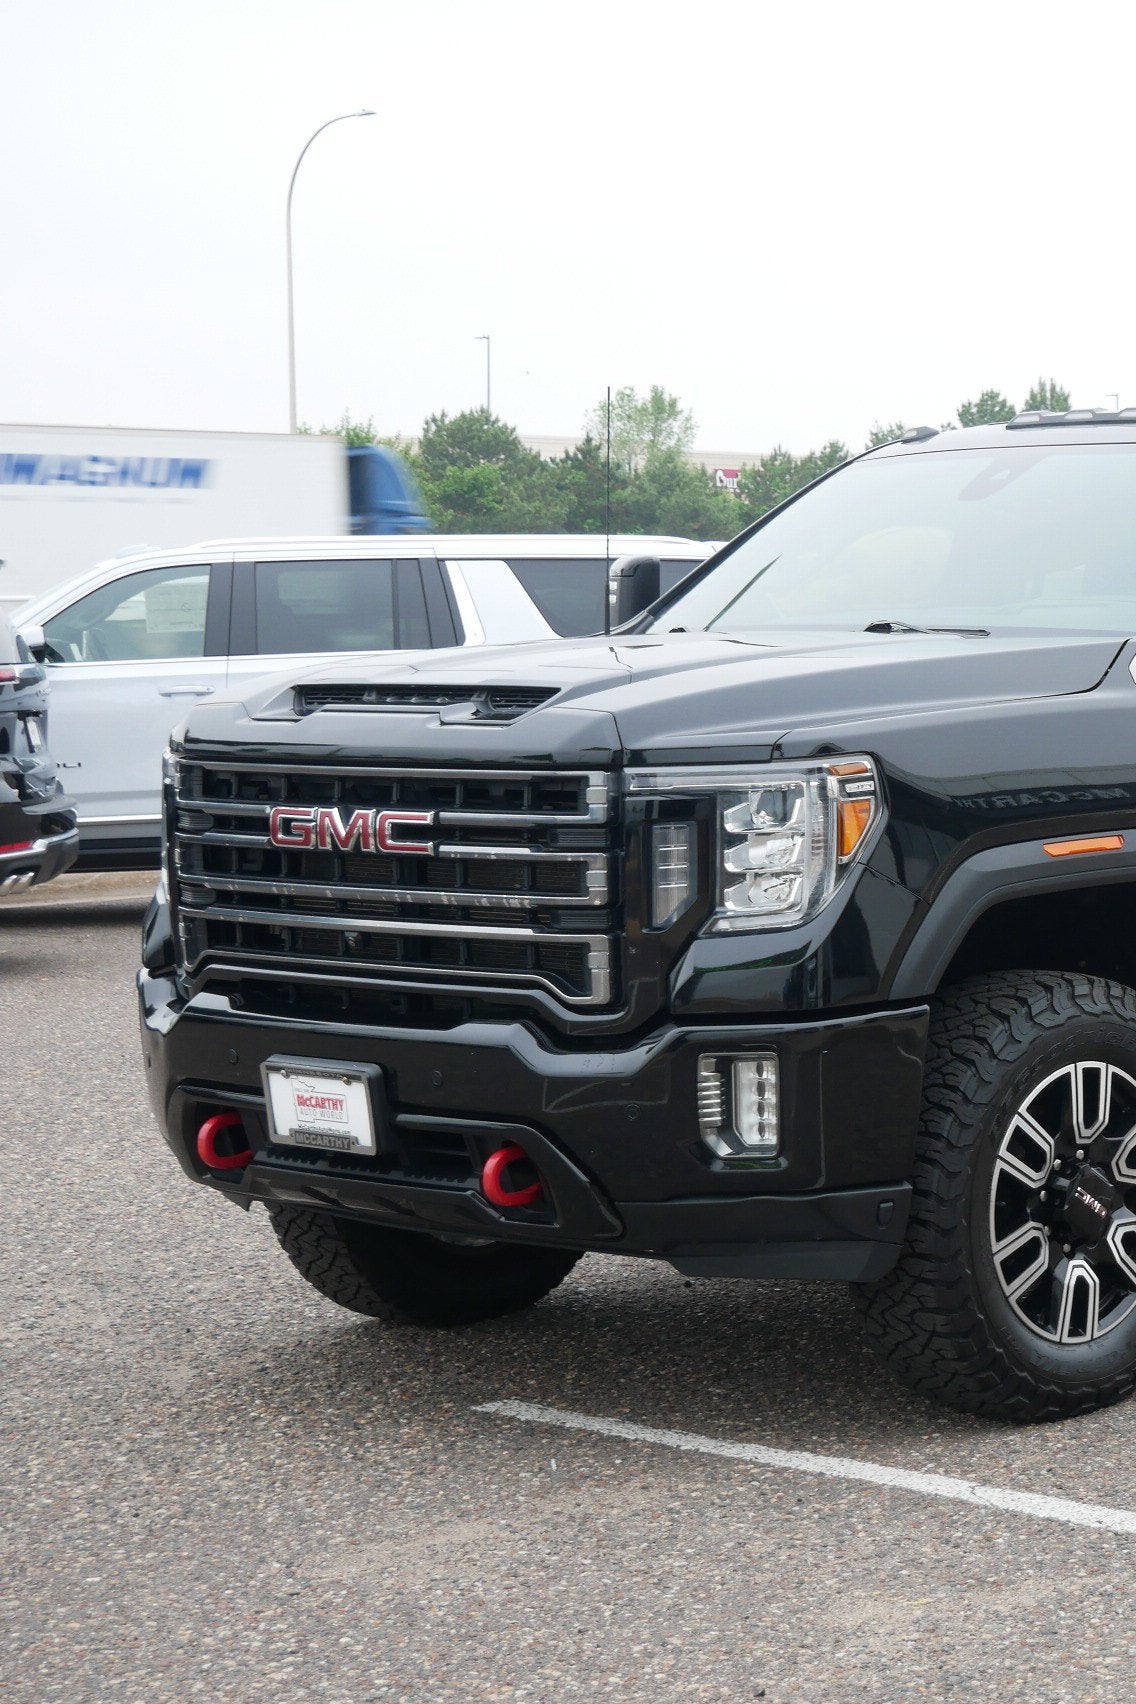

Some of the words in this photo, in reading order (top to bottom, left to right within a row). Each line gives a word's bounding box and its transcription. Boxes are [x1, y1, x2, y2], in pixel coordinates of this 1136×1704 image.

[270, 806, 435, 856] GMC
[296, 1094, 344, 1111] McCARTHY
[300, 1108, 318, 1117] AUTO
[319, 1110, 344, 1120] WORLD
[295, 1131, 351, 1149] MCCARTHY
